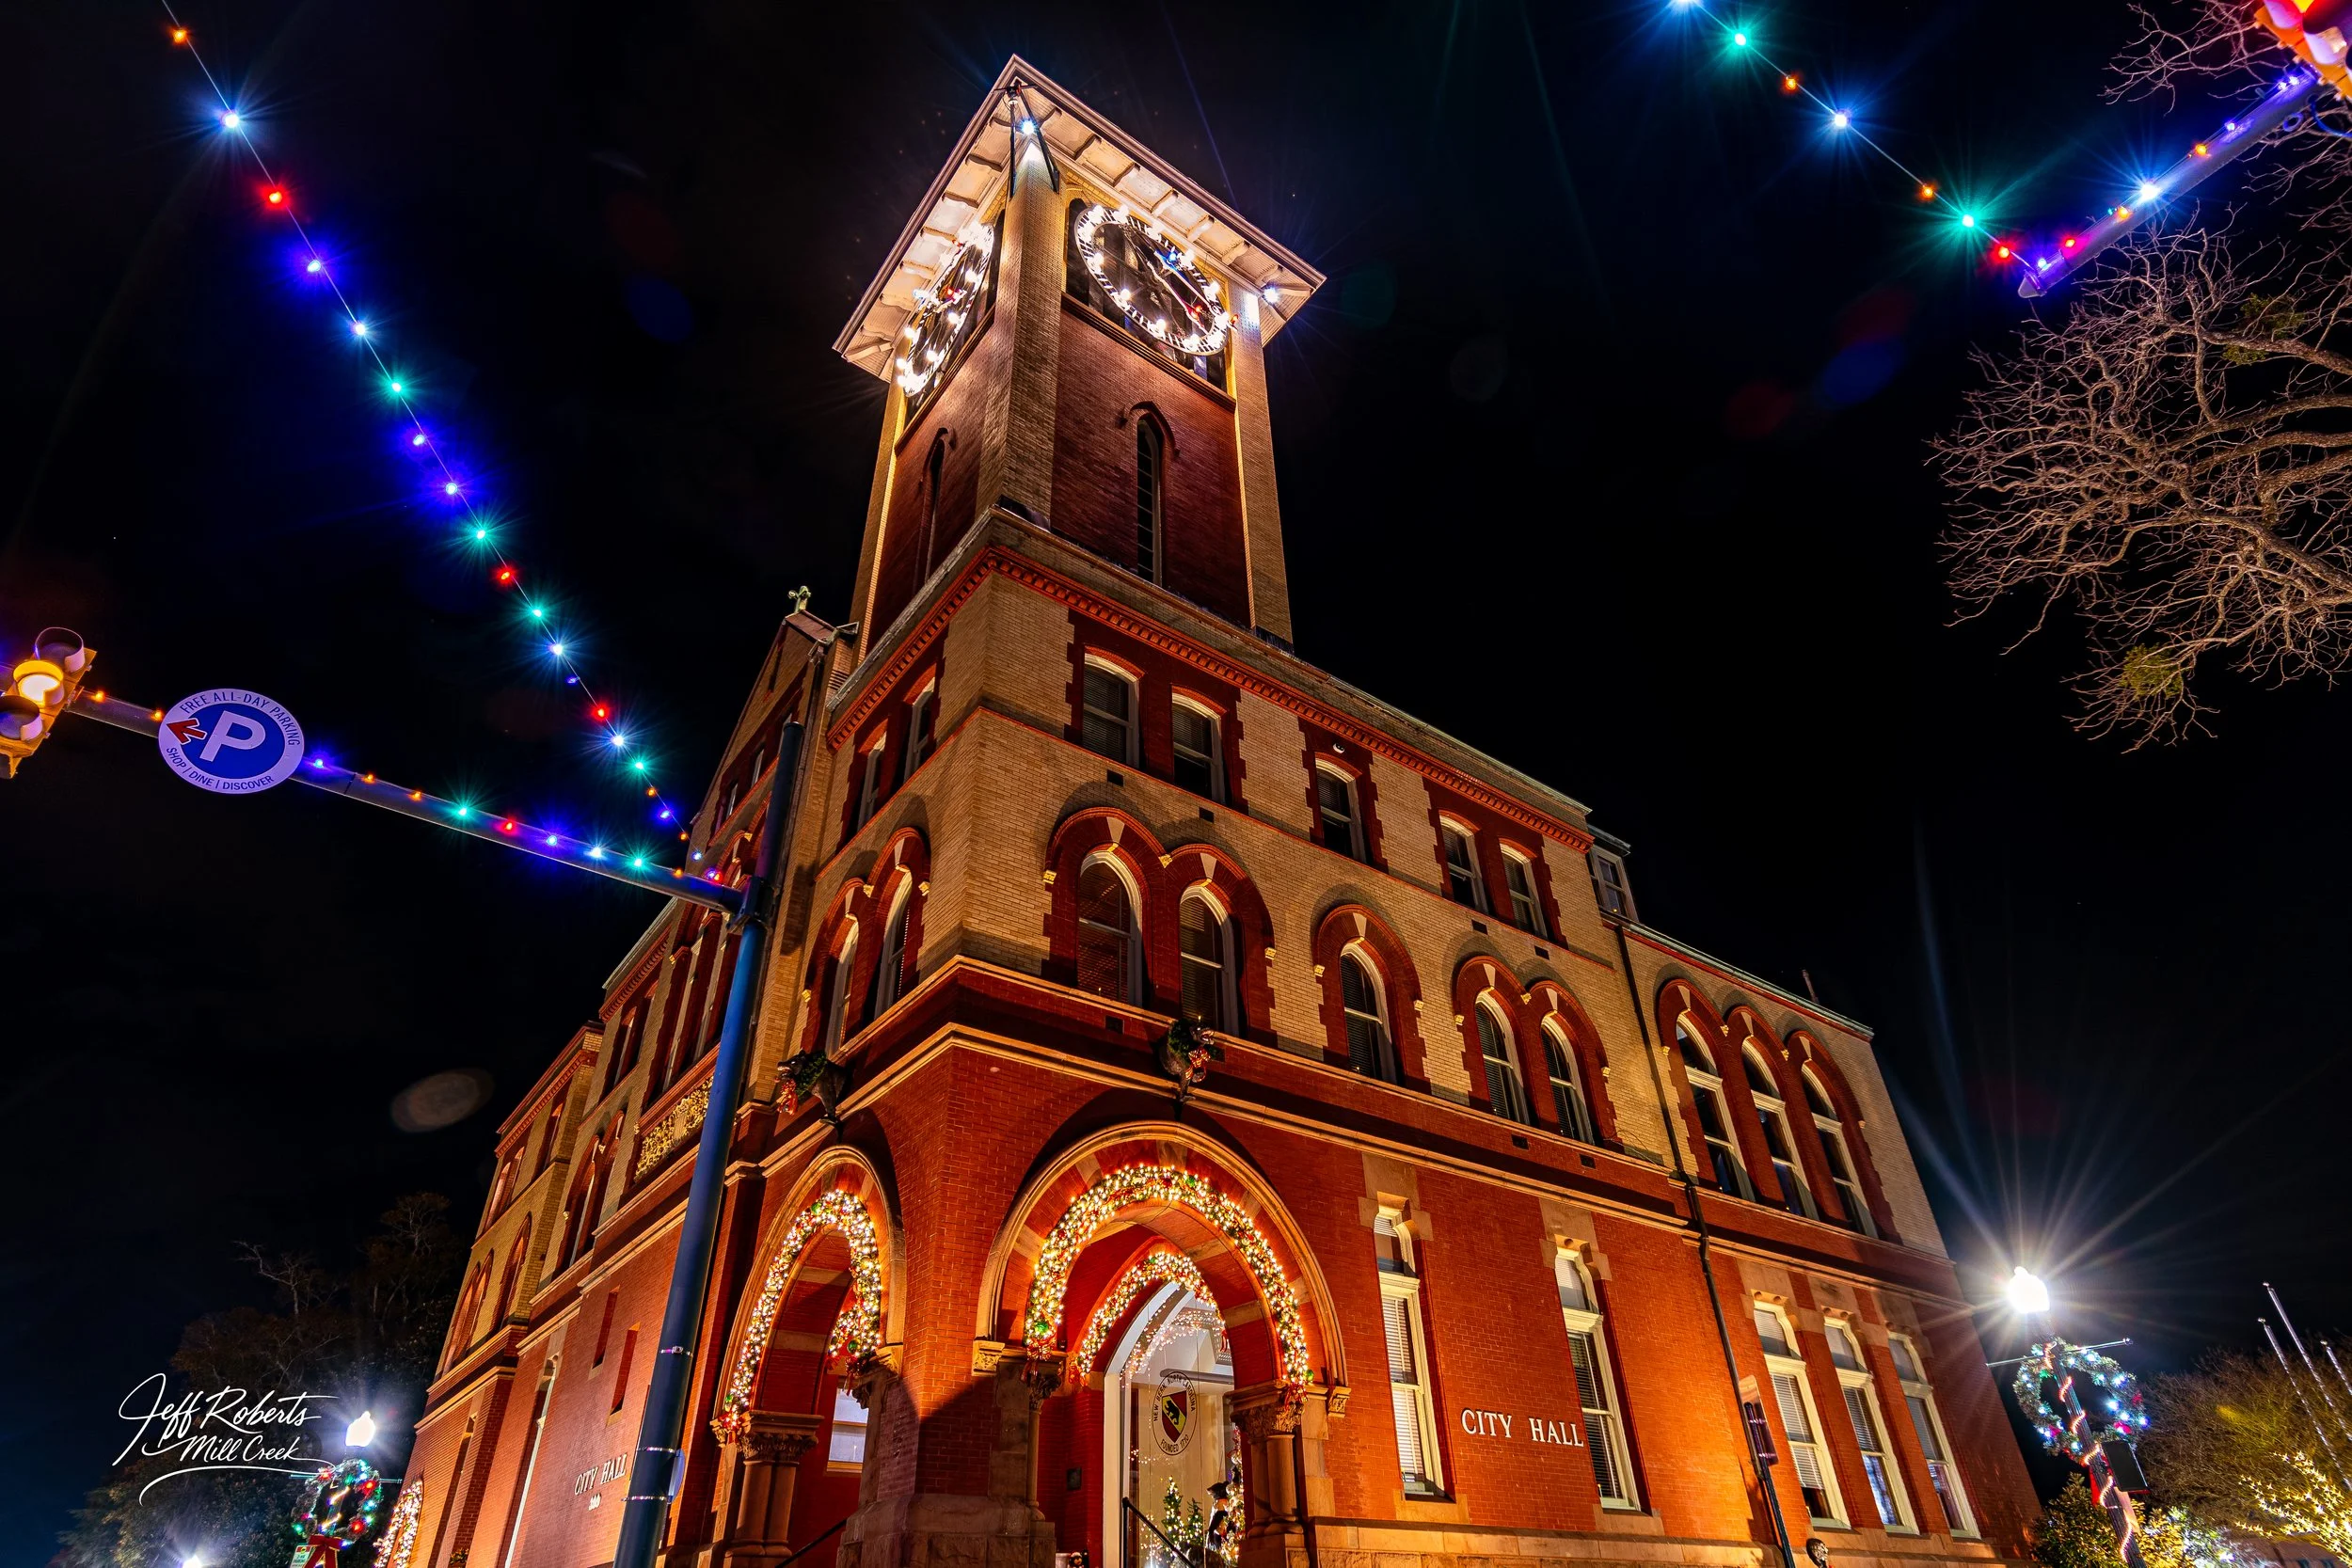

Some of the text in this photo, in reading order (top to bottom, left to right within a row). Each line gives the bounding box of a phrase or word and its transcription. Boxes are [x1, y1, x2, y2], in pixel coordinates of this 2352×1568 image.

[180, 691, 301, 746] FREE ALL-DAY PARKING
[199, 710, 266, 762] P
[167, 747, 275, 790] SHOP DINE DISCOVER
[1183, 1378, 1196, 1412] CAROLINA
[1461, 1409, 1584, 1448] CITY HALL
[574, 1453, 628, 1496] CITY HALL
